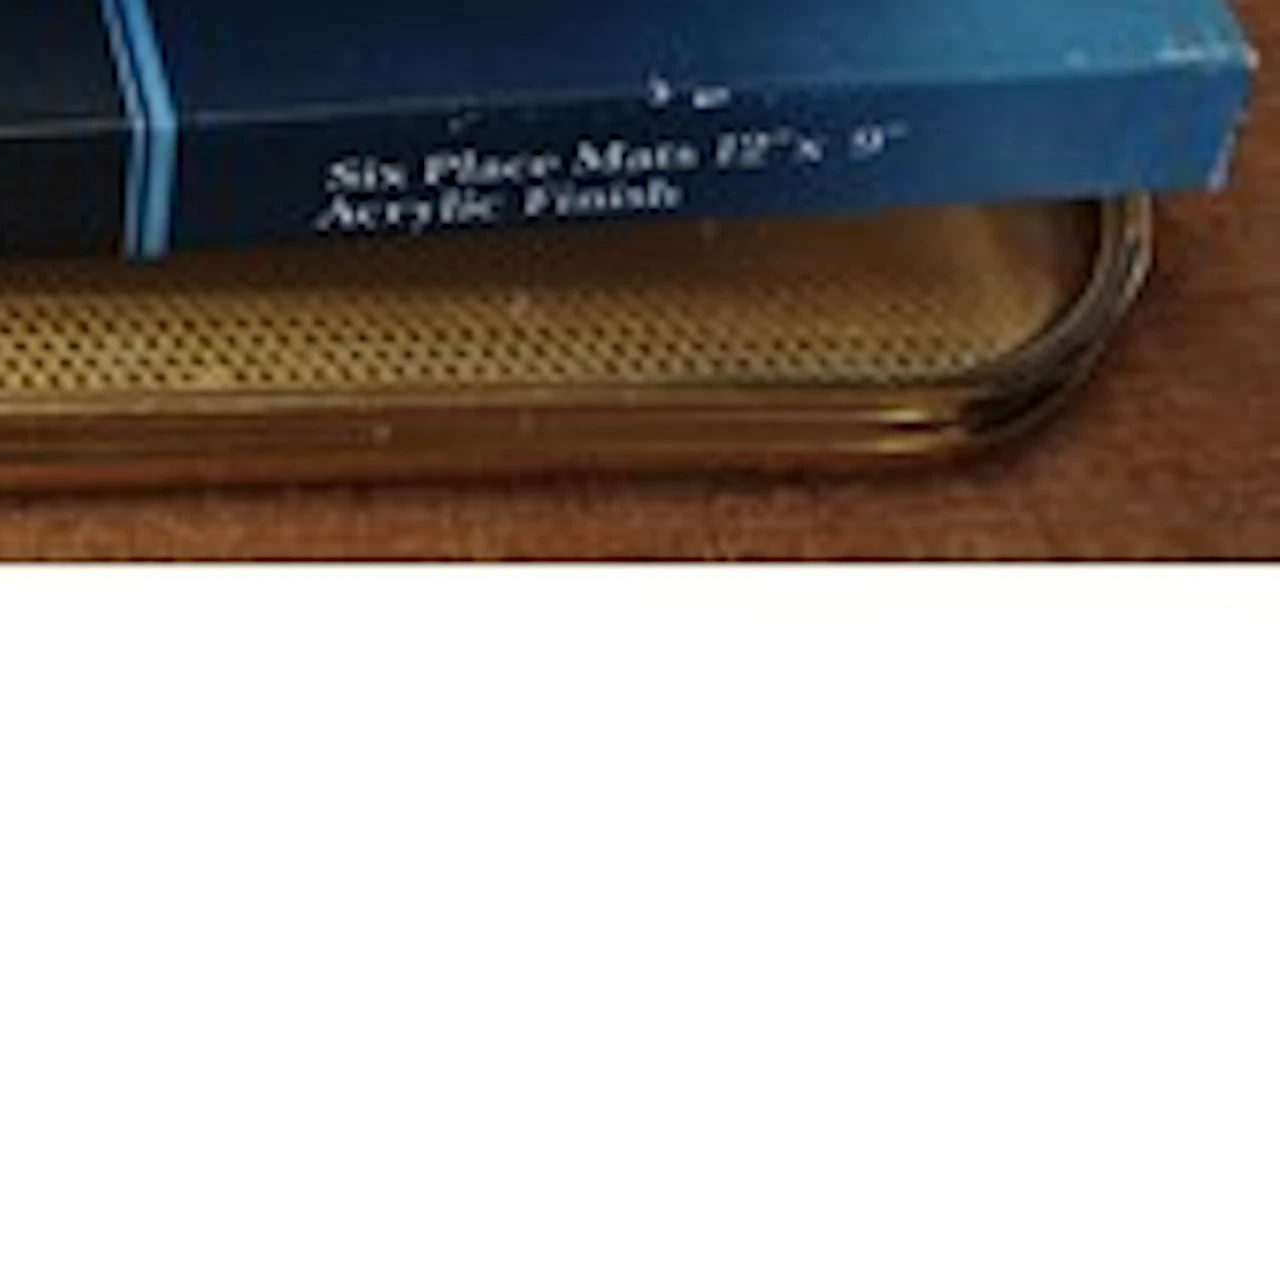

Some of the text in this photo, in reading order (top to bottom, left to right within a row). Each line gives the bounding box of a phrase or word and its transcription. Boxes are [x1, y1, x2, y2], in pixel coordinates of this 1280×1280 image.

[324, 154, 407, 192] Six
[422, 148, 563, 186] Place
[571, 137, 699, 176] Mats
[314, 180, 682, 237] Acrylic Finish
